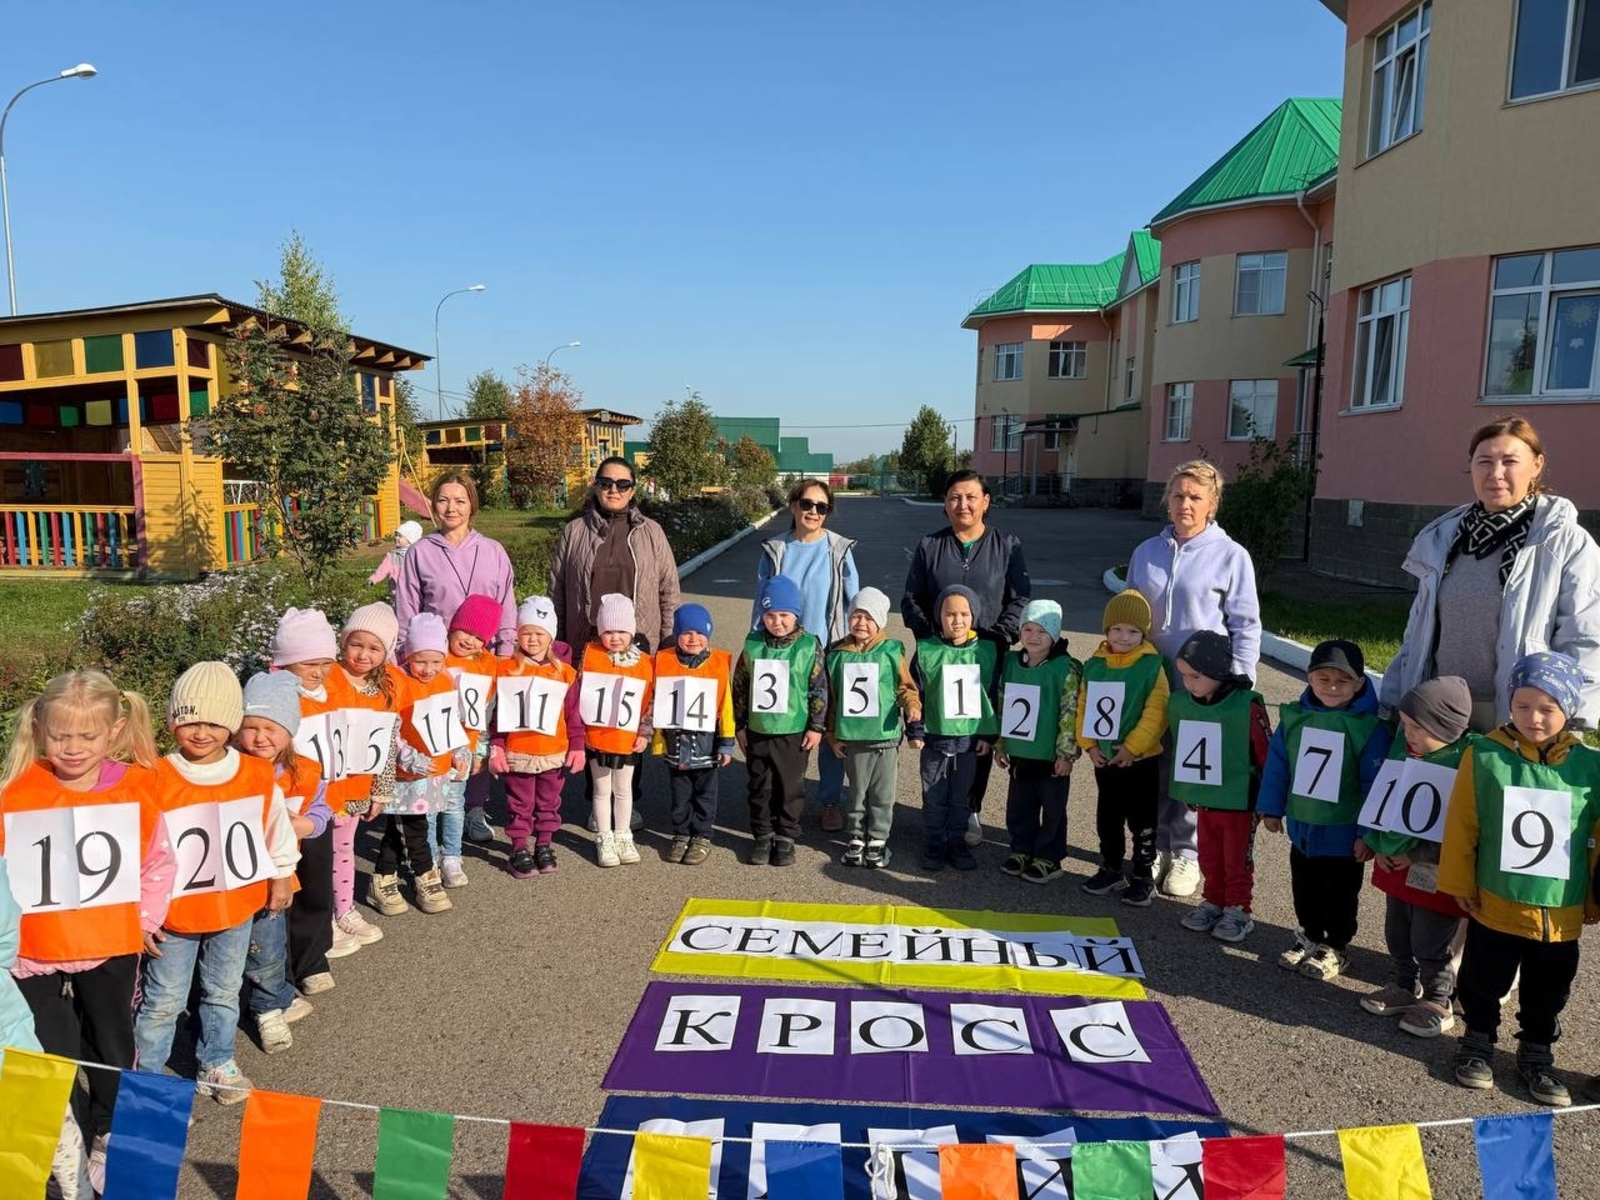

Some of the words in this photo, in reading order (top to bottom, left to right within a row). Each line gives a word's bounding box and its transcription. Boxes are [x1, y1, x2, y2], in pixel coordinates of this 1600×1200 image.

[514, 690, 549, 731] 11
[594, 687, 636, 727] 15
[670, 690, 708, 728] 14
[755, 672, 778, 710] 3
[848, 676, 869, 714] 5
[953, 678, 969, 716] 1
[422, 707, 451, 753] 17
[1010, 698, 1031, 737] 2
[1095, 696, 1116, 737] 8
[308, 733, 345, 780] 13
[1182, 737, 1212, 781] 4
[1303, 746, 1333, 795] 7
[1370, 779, 1442, 833] 10
[177, 821, 259, 890] 20
[1511, 810, 1554, 869] 9
[32, 831, 121, 907] 19
[663, 1008, 1137, 1058] КРОСС
